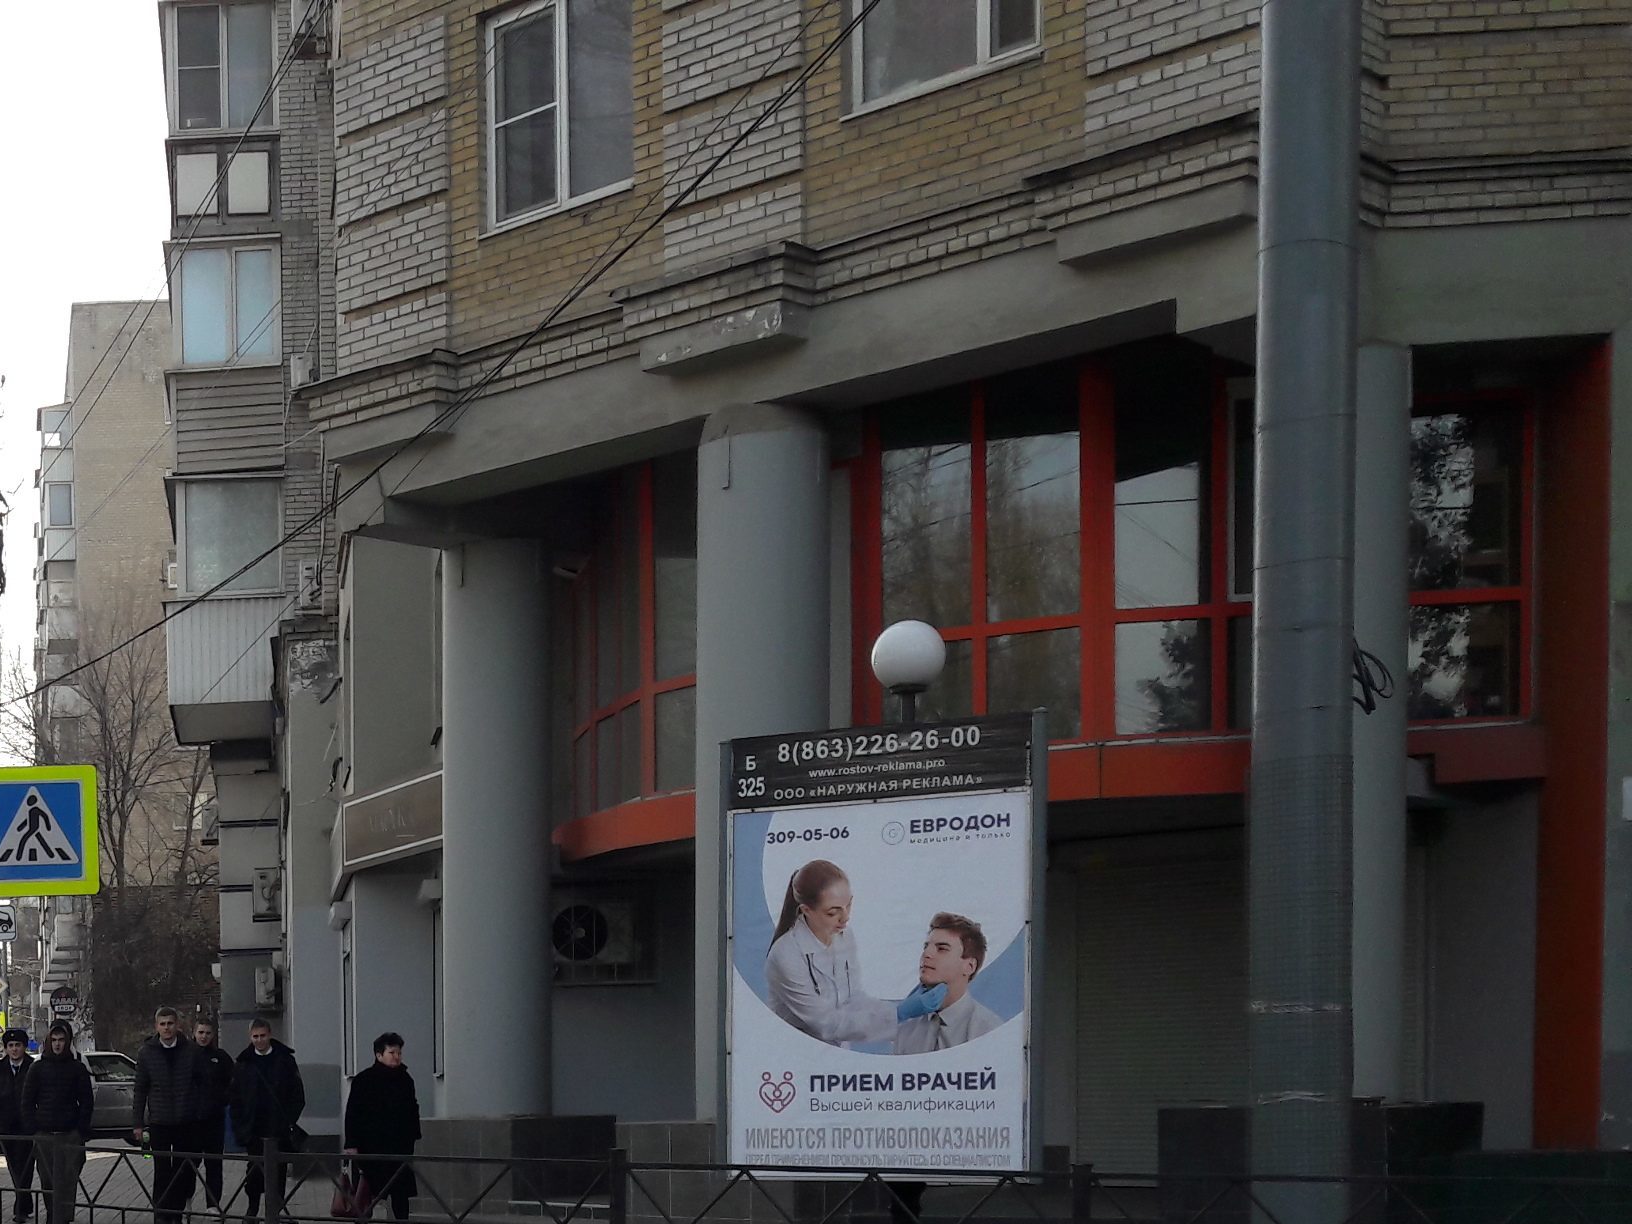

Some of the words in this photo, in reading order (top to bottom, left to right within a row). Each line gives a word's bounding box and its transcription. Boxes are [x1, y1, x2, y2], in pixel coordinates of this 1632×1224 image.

[777, 726, 981, 766] 8(863)226-26-00
[744, 755, 757, 772] Б
[808, 758, 946, 779] www.rostov-reklama.pro
[737, 777, 766, 798] 325
[773, 787, 805, 801] ООО
[809, 779, 898, 798] «НАРУЖНАЯ
[902, 774, 984, 791] РЕКЛАМА»
[909, 812, 1011, 835] ЕВРОДОН
[766, 826, 851, 845] 309-05-06
[809, 1073, 894, 1093] ПРИЕМ
[901, 1066, 997, 1091] ВРАЧЕЙ
[810, 1097, 873, 1113] Высшей
[877, 1096, 996, 1114] квалификации
[745, 1127, 826, 1150] ИМЕЮТСЯ
[831, 1126, 1011, 1150] ПРОТИВОПОКАЗАНИЯ
